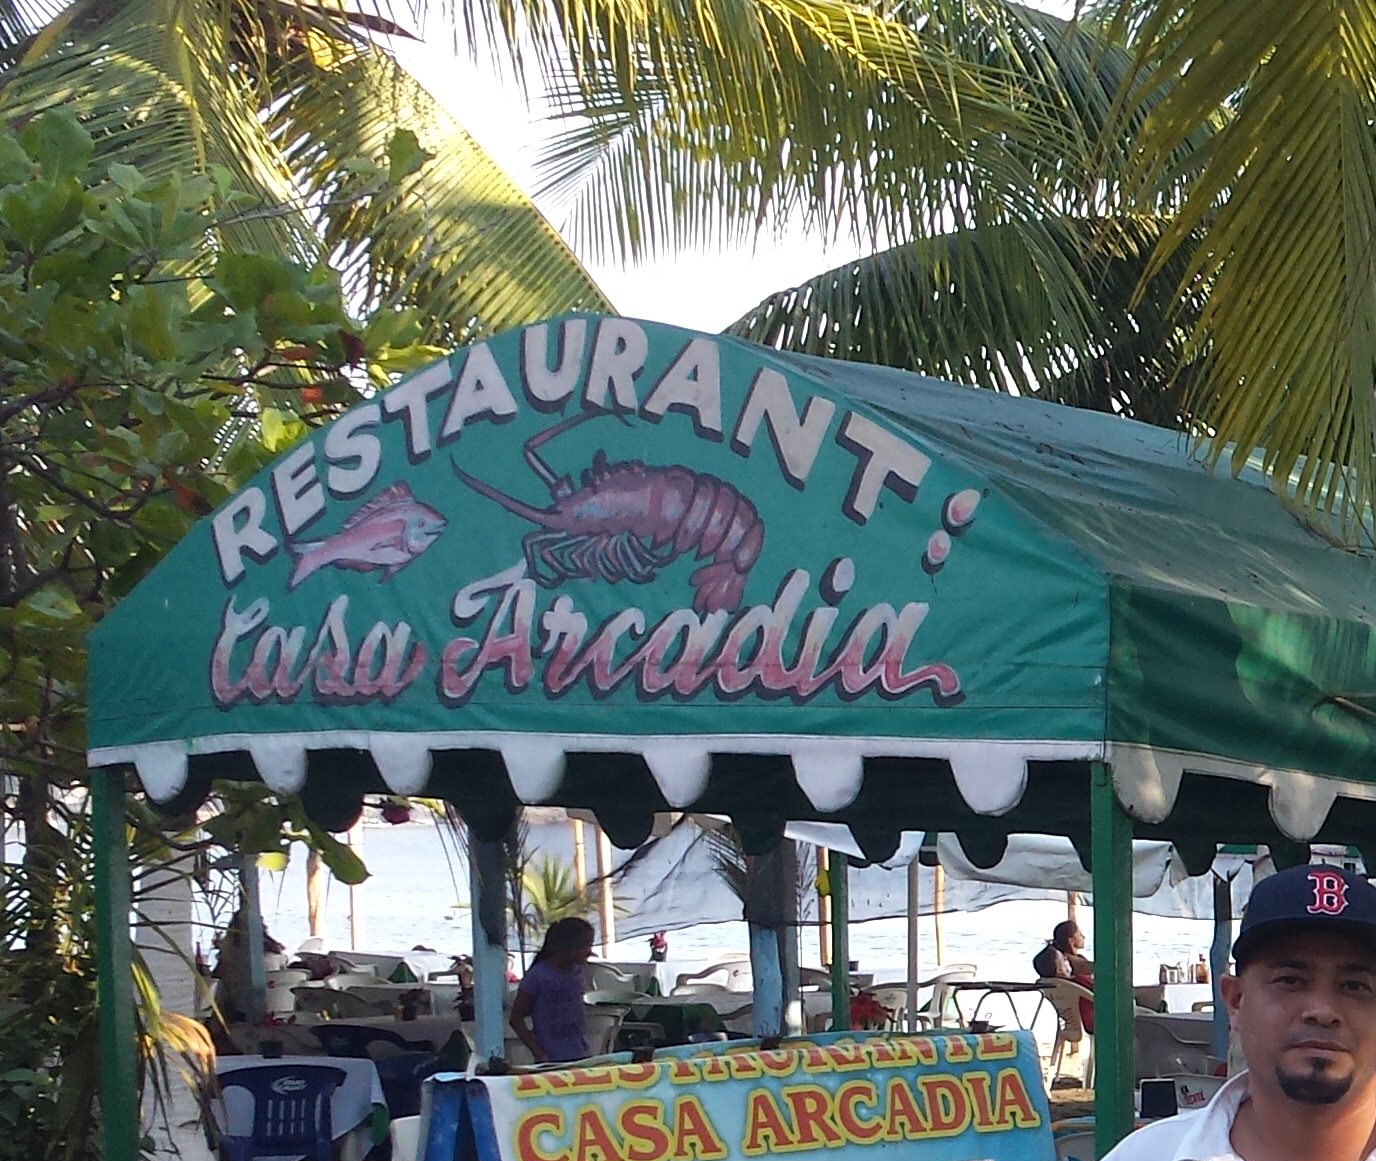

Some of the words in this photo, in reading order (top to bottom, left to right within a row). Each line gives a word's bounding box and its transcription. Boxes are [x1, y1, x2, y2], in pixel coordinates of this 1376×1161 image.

[211, 318, 930, 586] RESTAURANT
[209, 594, 424, 706] Casa
[439, 555, 966, 706] Arcadia
[1306, 870, 1350, 915] B
[742, 1068, 1041, 1158] ARCADIA
